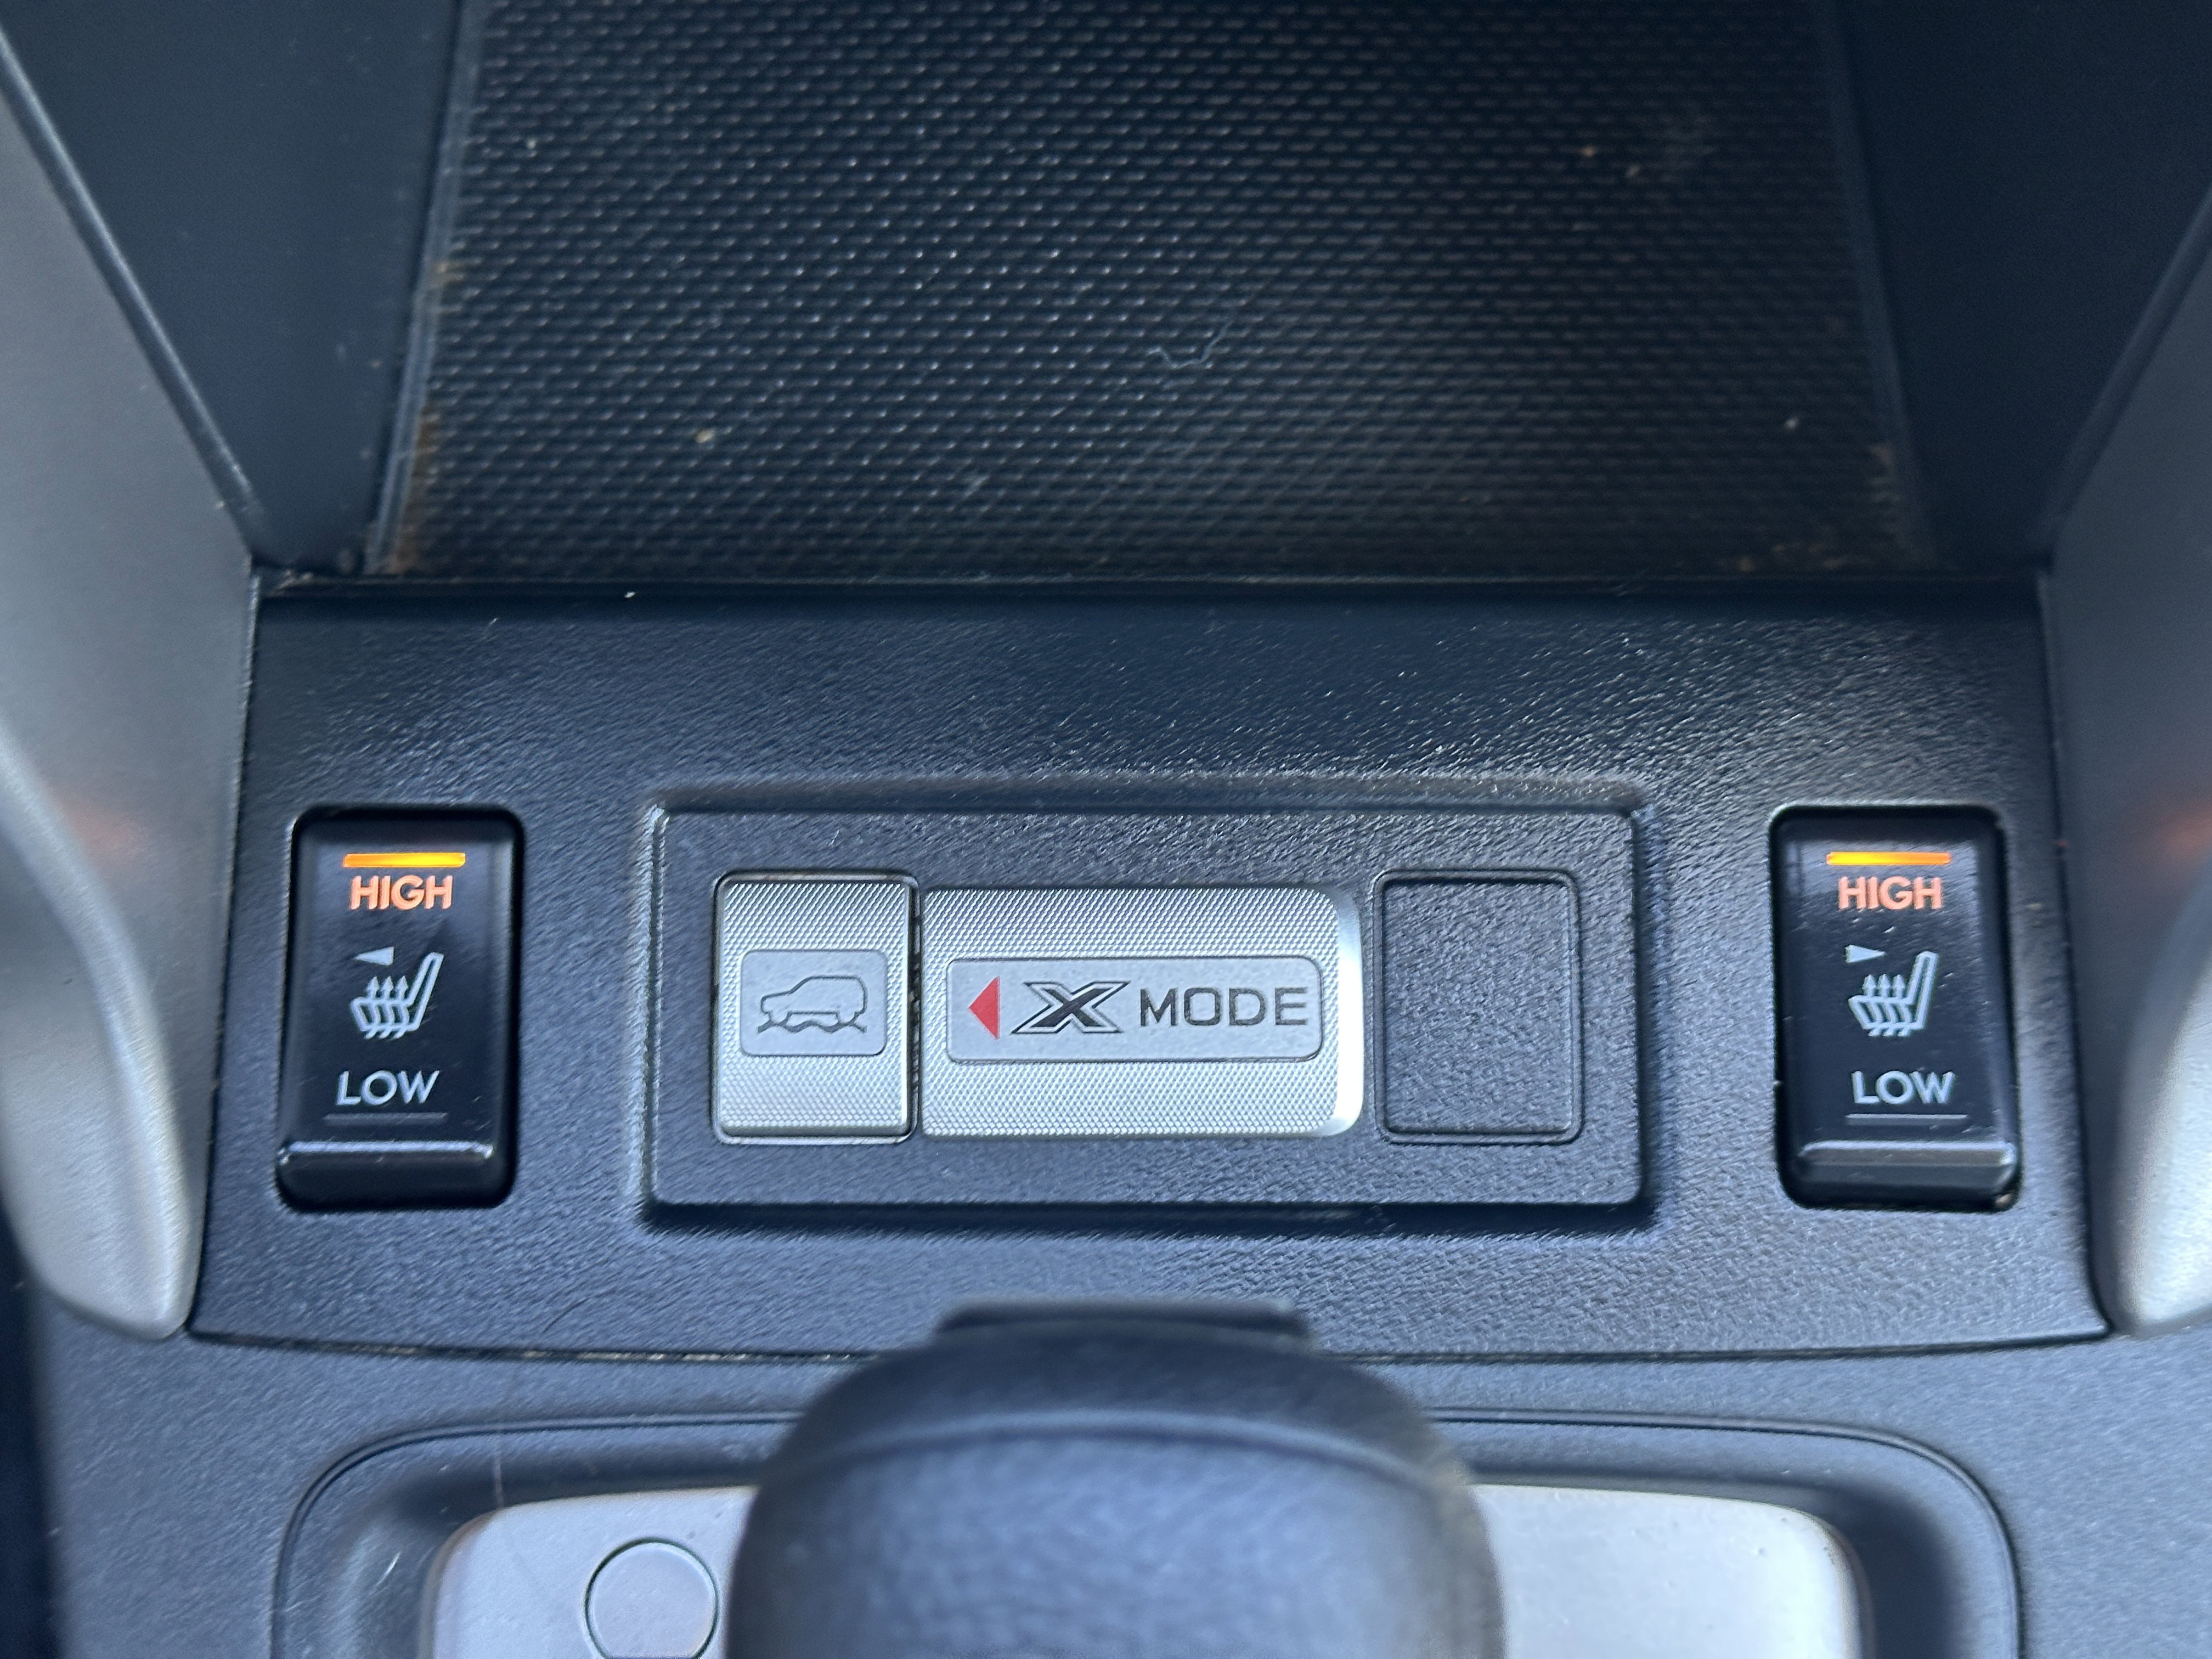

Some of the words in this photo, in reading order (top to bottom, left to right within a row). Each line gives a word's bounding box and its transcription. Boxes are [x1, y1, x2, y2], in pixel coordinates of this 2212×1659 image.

[349, 875, 453, 910] HIGH
[1838, 876, 1942, 910] HIGH
[1010, 980, 1131, 1035] X
[1139, 987, 1308, 1027] MODE
[336, 1070, 439, 1105] LOW
[1851, 1070, 1955, 1104] LOW
